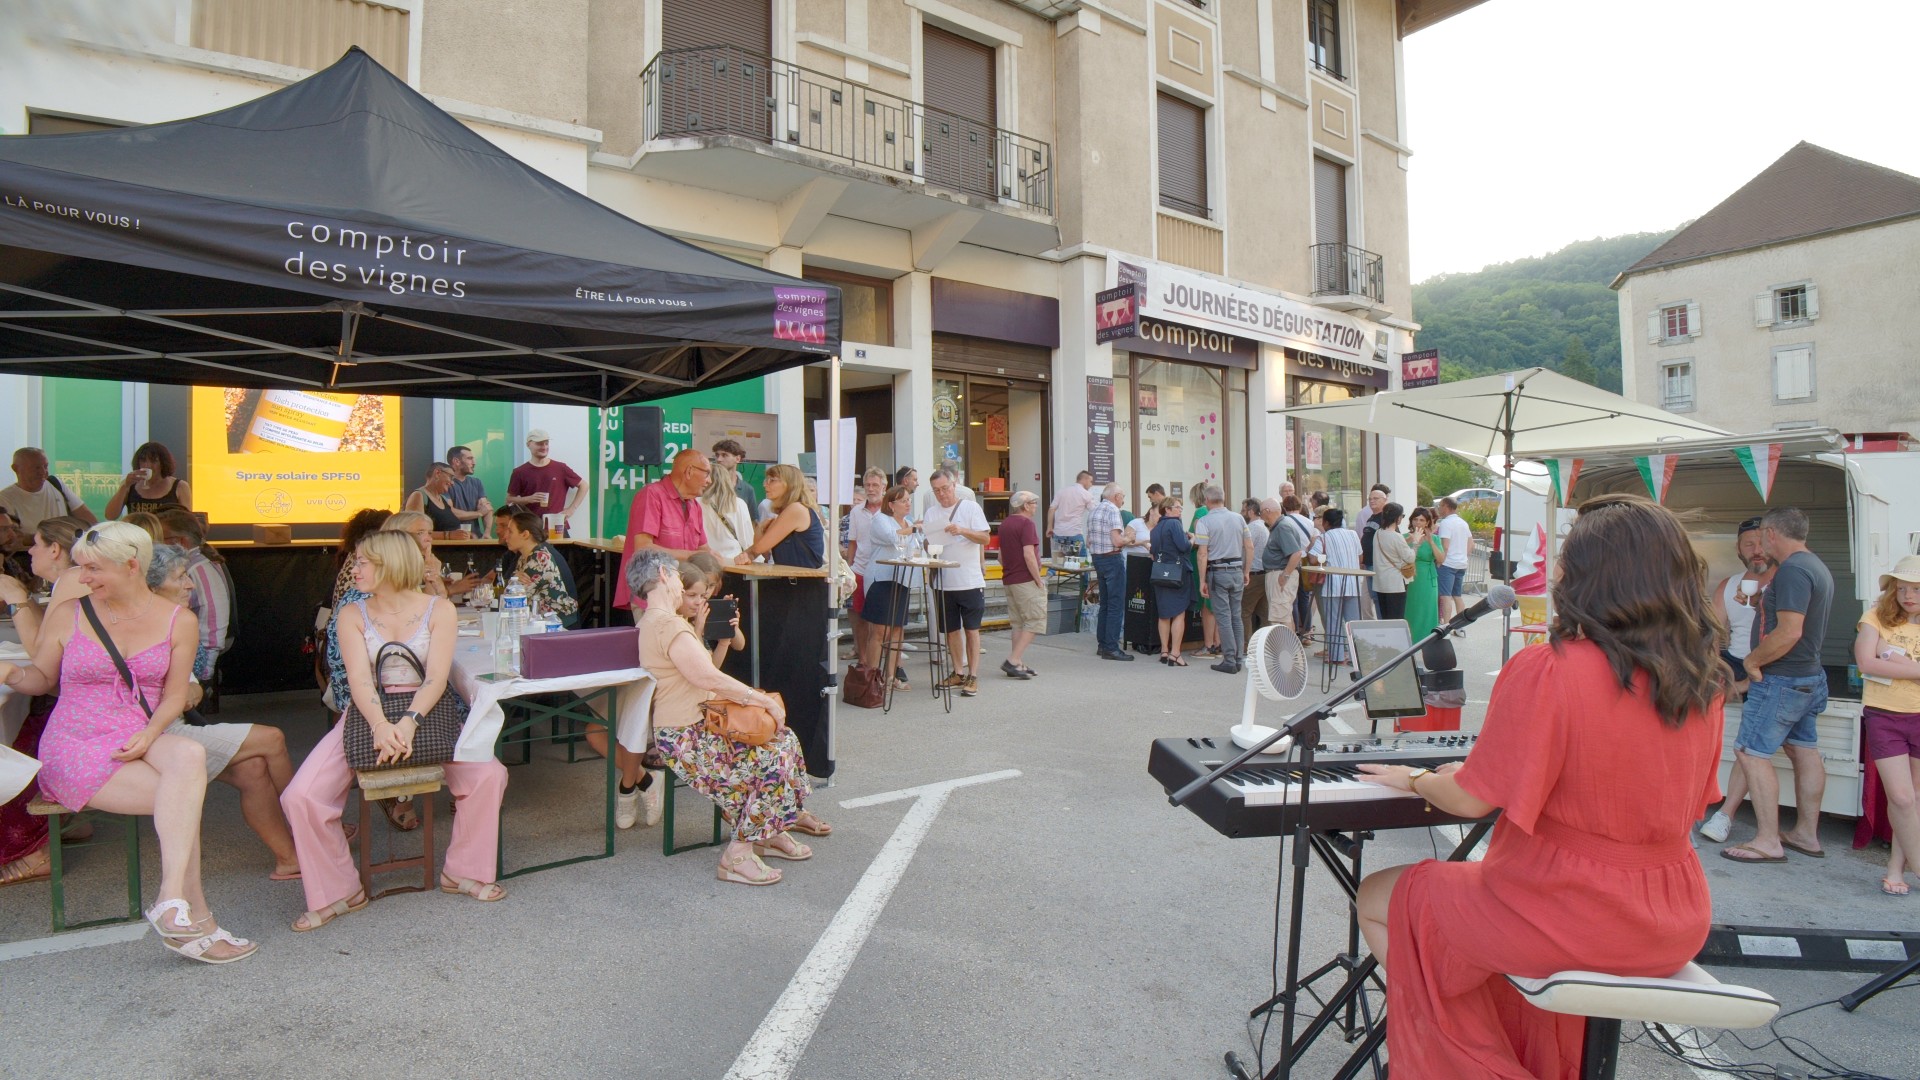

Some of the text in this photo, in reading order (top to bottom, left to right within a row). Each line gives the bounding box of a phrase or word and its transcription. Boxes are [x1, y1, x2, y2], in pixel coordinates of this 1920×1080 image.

[5, 195, 29, 209] LÀ
[33, 201, 80, 219] POUR
[85, 210, 130, 228] VOUS
[287, 221, 467, 266] comptoir
[284, 251, 466, 298] des vignes
[1118, 266, 1147, 279] comptoir
[575, 287, 605, 301] ÊTRE
[608, 293, 623, 303] LÀ
[626, 296, 656, 305] POUR
[658, 299, 687, 307] VOUS
[777, 294, 825, 305] comptoir
[1097, 287, 1133, 303] comptoir
[777, 302, 824, 317] des vignes
[1163, 282, 1365, 350] JOURNÉES DÉGUSTATION
[1097, 324, 1134, 339] des vignes
[1139, 320, 1235, 354] comptoir
[1297, 350, 1324, 368] des
[1403, 351, 1436, 361] comptoir
[1416, 378, 1437, 387] vignes
[273, 394, 329, 418] High protection
[1146, 420, 1161, 431] des
[1163, 423, 1189, 435] vignes
[236, 471, 361, 482] Spray solaire SPF50
